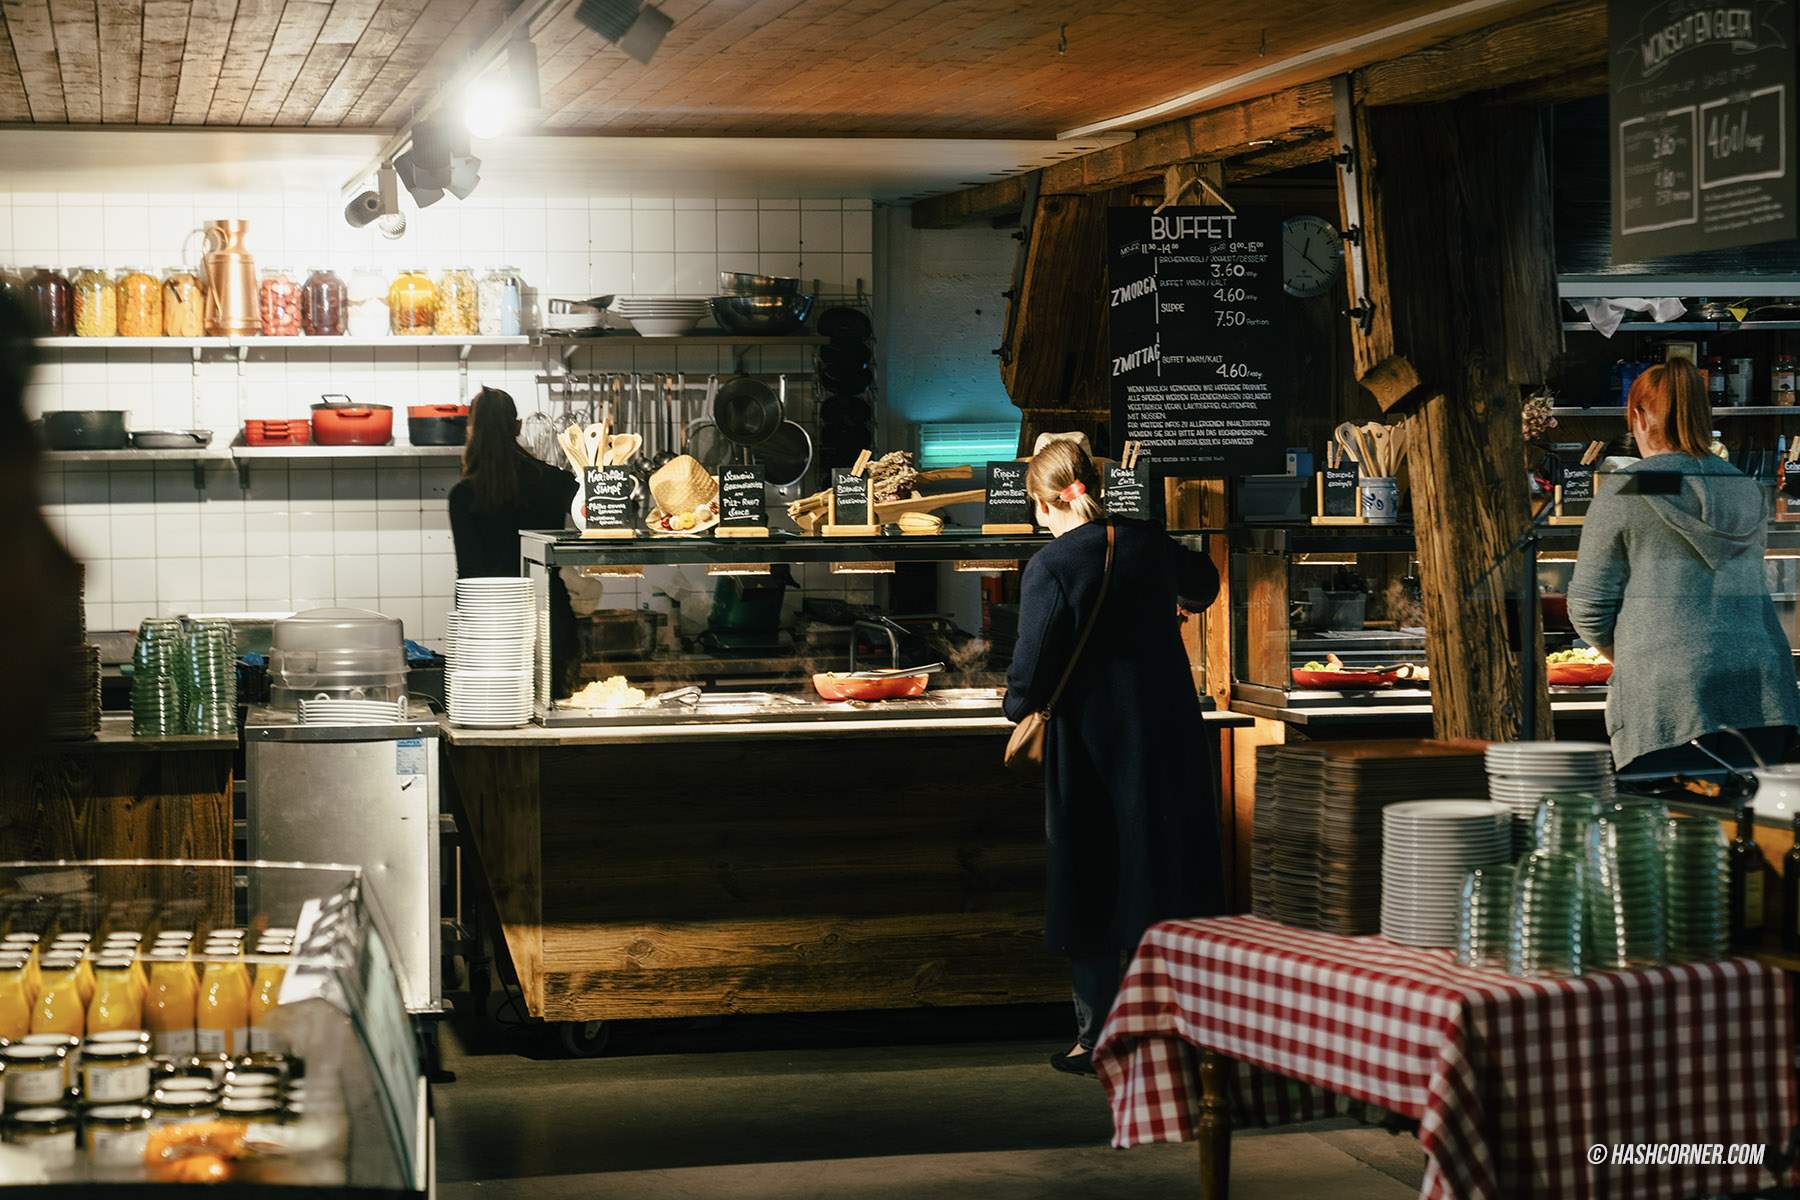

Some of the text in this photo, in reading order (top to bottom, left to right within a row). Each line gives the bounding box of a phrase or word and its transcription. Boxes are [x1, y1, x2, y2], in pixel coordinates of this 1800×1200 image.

[1151, 215, 1237, 240] BUFFET
[1210, 263, 1246, 278] 3.60
[1213, 288, 1246, 302] 4.60
[1160, 303, 1185, 313] SUPPE
[1214, 310, 1246, 327] 7.50
[1162, 355, 1185, 364] BUFFET
[1215, 363, 1248, 379] 4.60
[1127, 412, 1140, 421] MIT
[1178, 429, 1196, 437] BITTE
